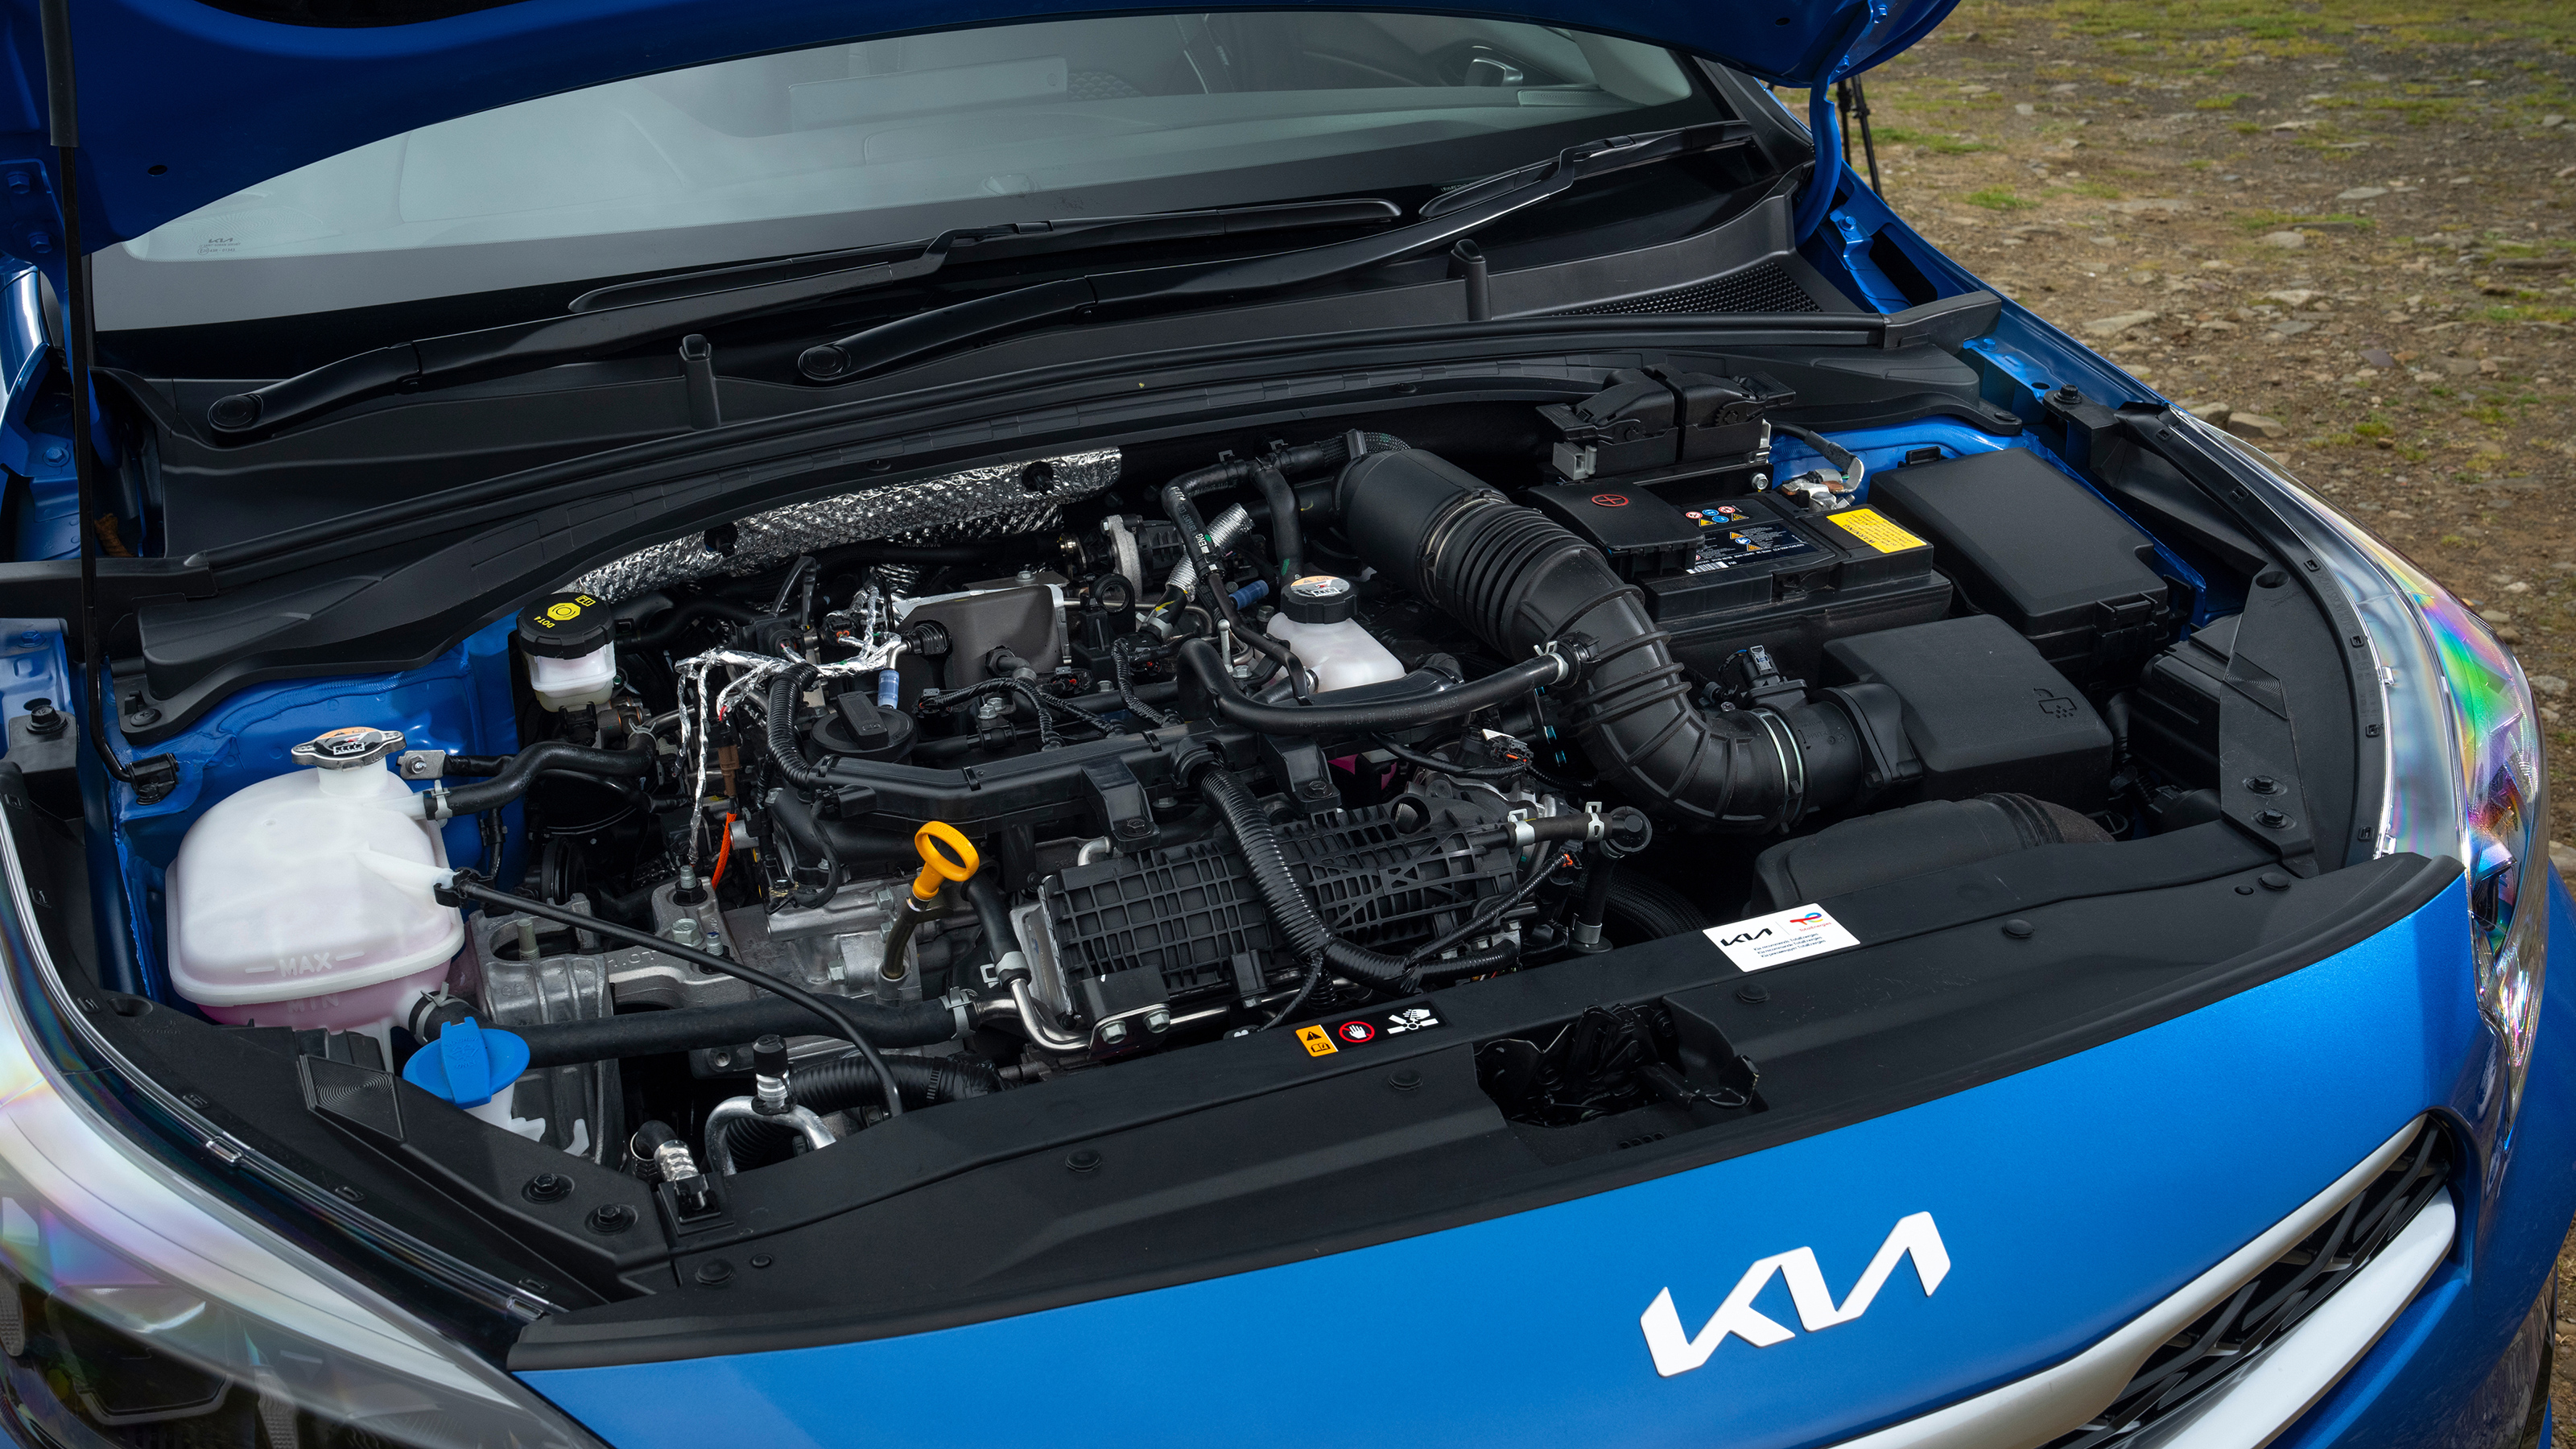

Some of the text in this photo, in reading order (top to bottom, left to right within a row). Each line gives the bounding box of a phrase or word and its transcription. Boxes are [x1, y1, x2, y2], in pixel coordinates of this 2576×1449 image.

[1195, 533, 1208, 546] ENG
[1843, 524, 1876, 544] WARNING
[534, 616, 555, 629] DOT4
[936, 824, 973, 856] ENGINE OIL
[1799, 922, 1832, 932] TotalEnergies
[1720, 927, 1773, 947] KIA
[1790, 932, 1819, 943] TotalEnergies
[1794, 935, 1823, 947] TotalEnergies
[1797, 939, 1827, 949] TotalEnergies
[279, 952, 332, 977] MAX
[287, 993, 340, 1013] MIN
[1640, 1211, 1951, 1378] KIA
